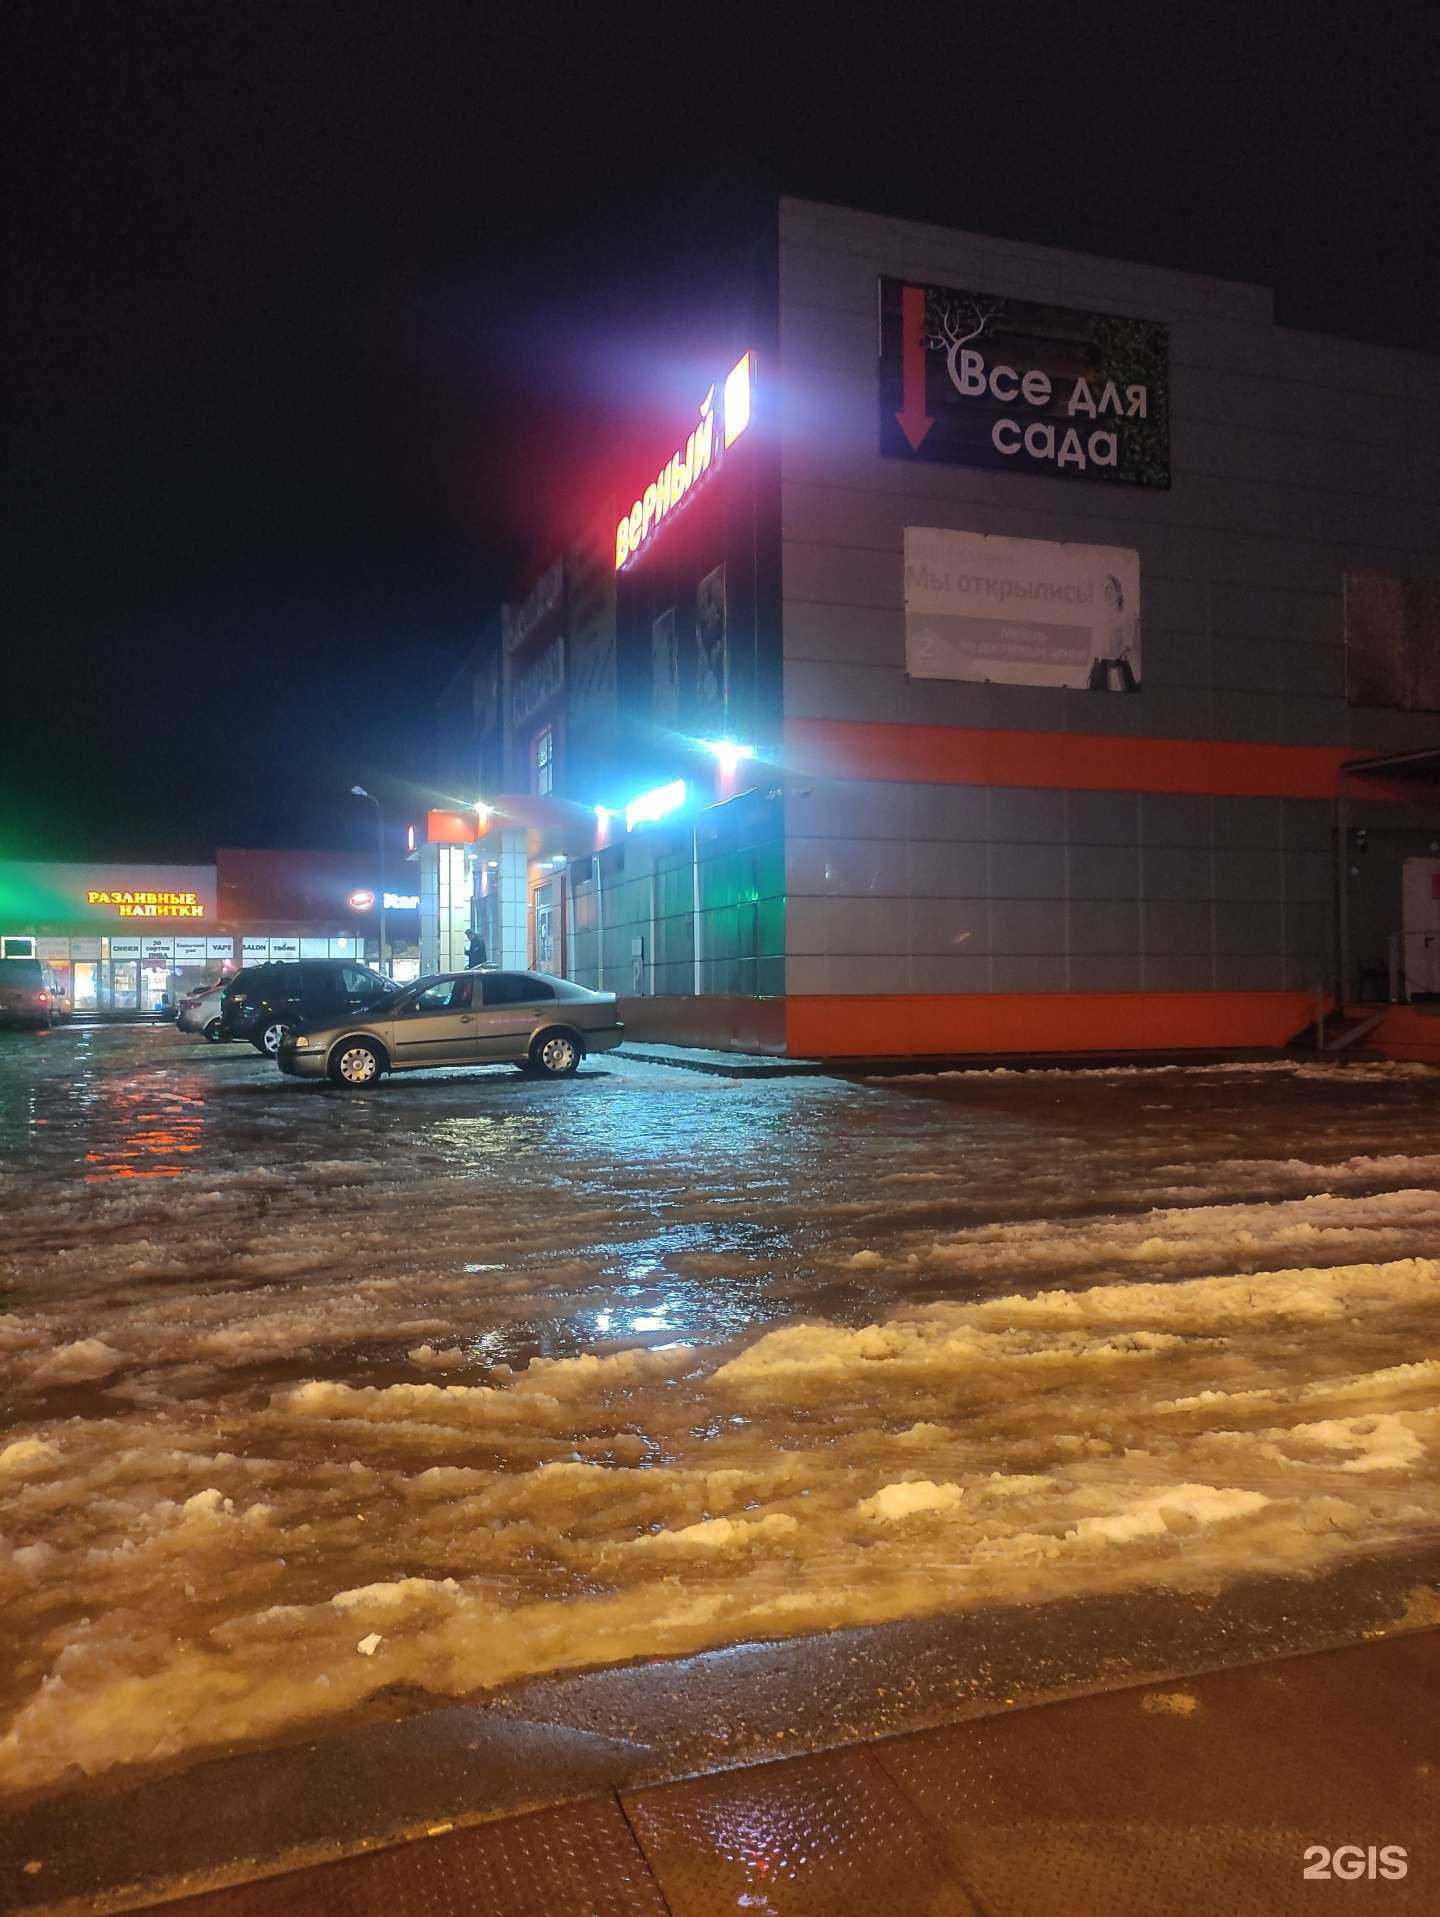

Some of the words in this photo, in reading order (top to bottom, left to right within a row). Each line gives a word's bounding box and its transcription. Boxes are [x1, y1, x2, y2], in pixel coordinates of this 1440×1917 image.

[949, 349, 1052, 406] Все
[1066, 376, 1148, 419] для
[991, 418, 1118, 470] сада
[906, 565, 952, 593] Мы
[87, 890, 197, 904] РАЗЛИВНЫЕ
[119, 904, 204, 917] НАПИТКИ
